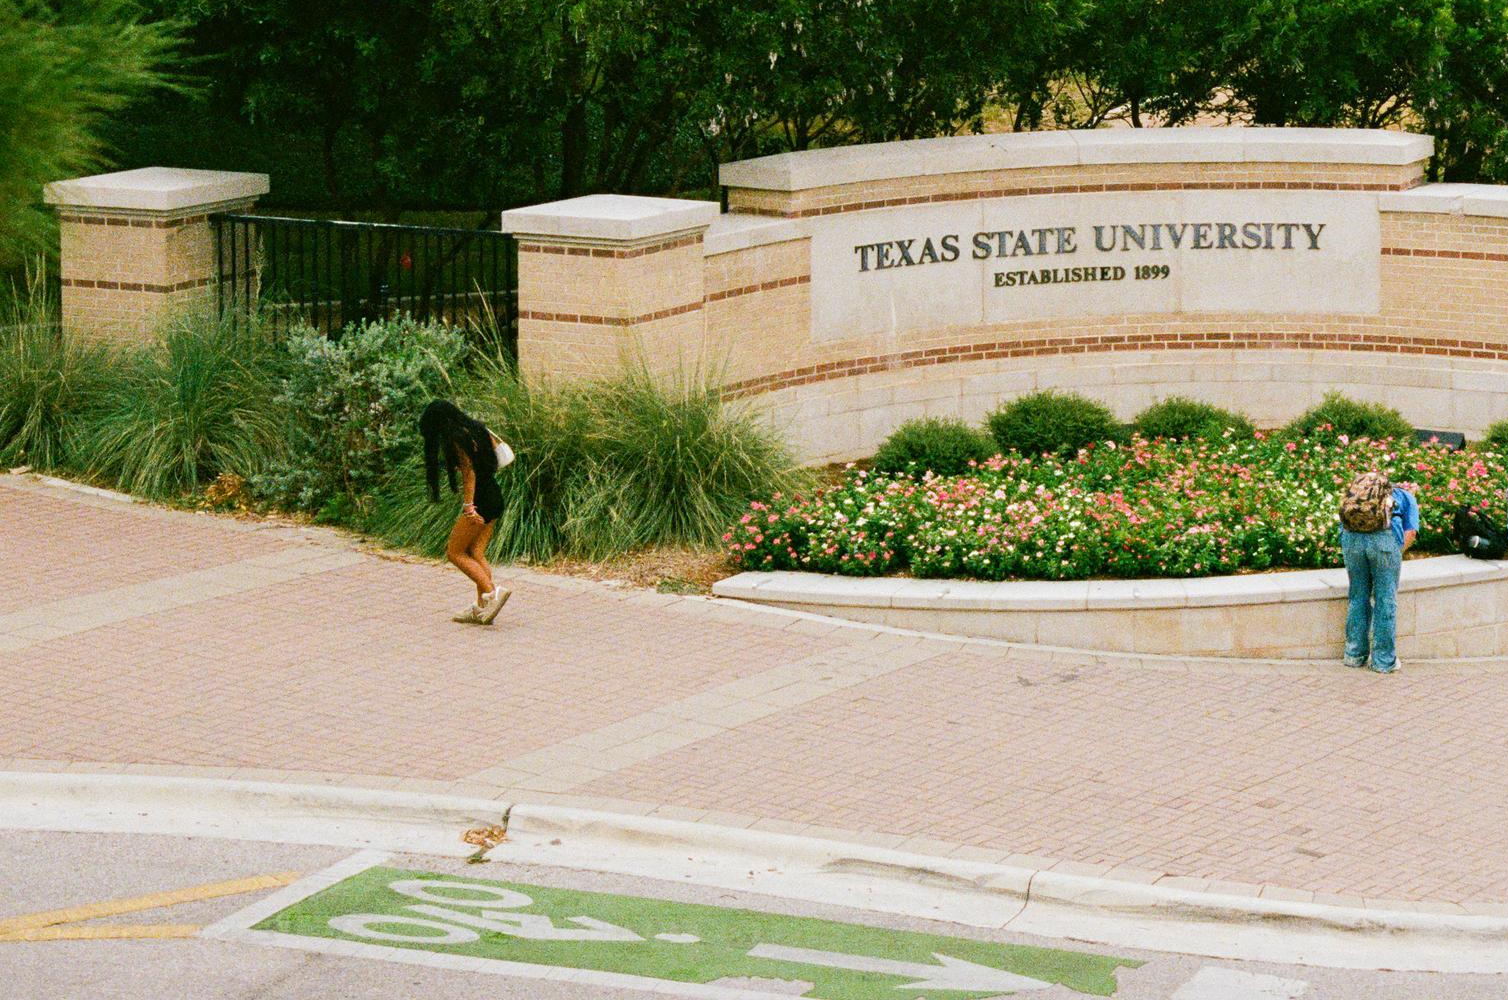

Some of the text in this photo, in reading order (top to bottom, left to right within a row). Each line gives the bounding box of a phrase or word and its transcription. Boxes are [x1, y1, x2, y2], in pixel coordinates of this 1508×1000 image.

[854, 222, 1327, 272] TEXAS STATE UNIVERSITY
[994, 264, 1170, 288] ESTABLISHED 1899
